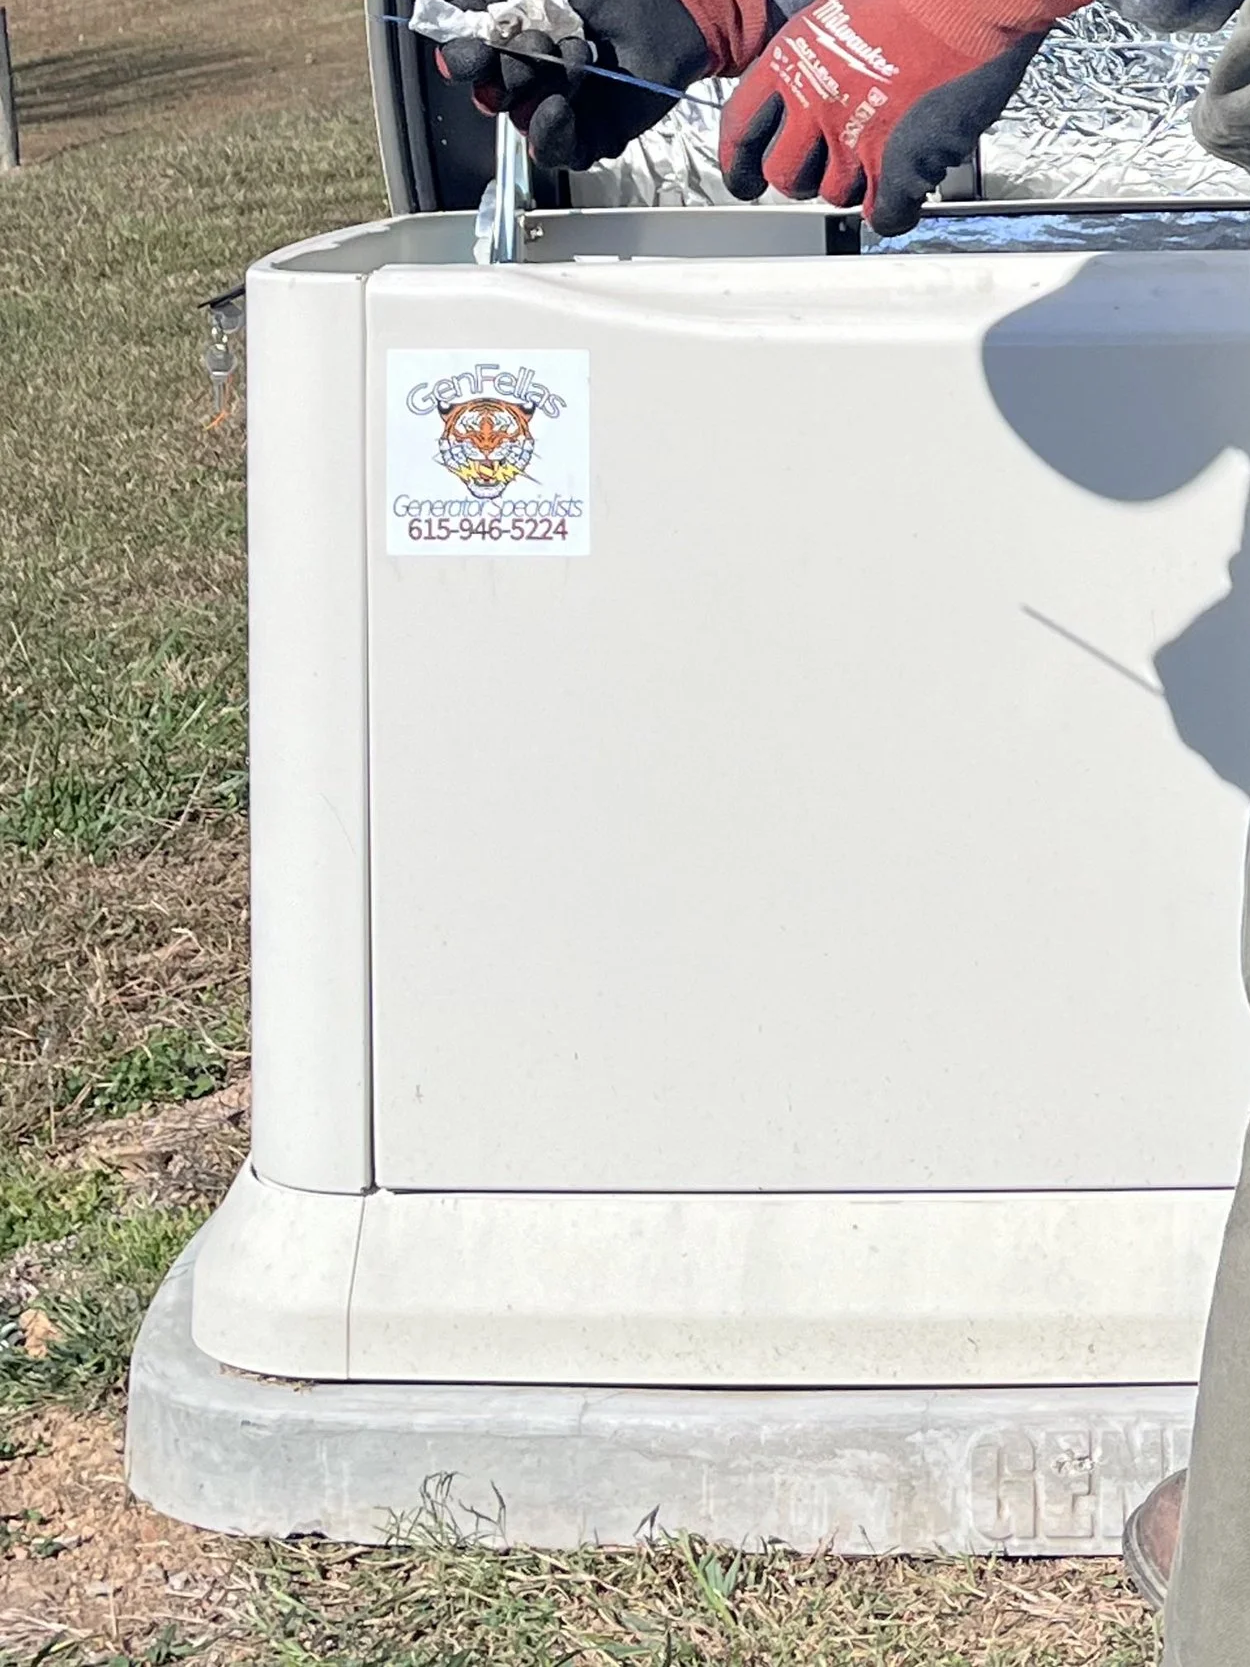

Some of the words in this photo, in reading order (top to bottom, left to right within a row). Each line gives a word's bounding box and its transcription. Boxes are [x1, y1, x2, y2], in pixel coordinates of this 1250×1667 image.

[406, 364, 567, 419] GenFellas
[393, 494, 485, 518] Generator
[490, 493, 584, 521] Specialists
[408, 518, 568, 541] 615-946-5224
[970, 1427, 1193, 1541] GEN
